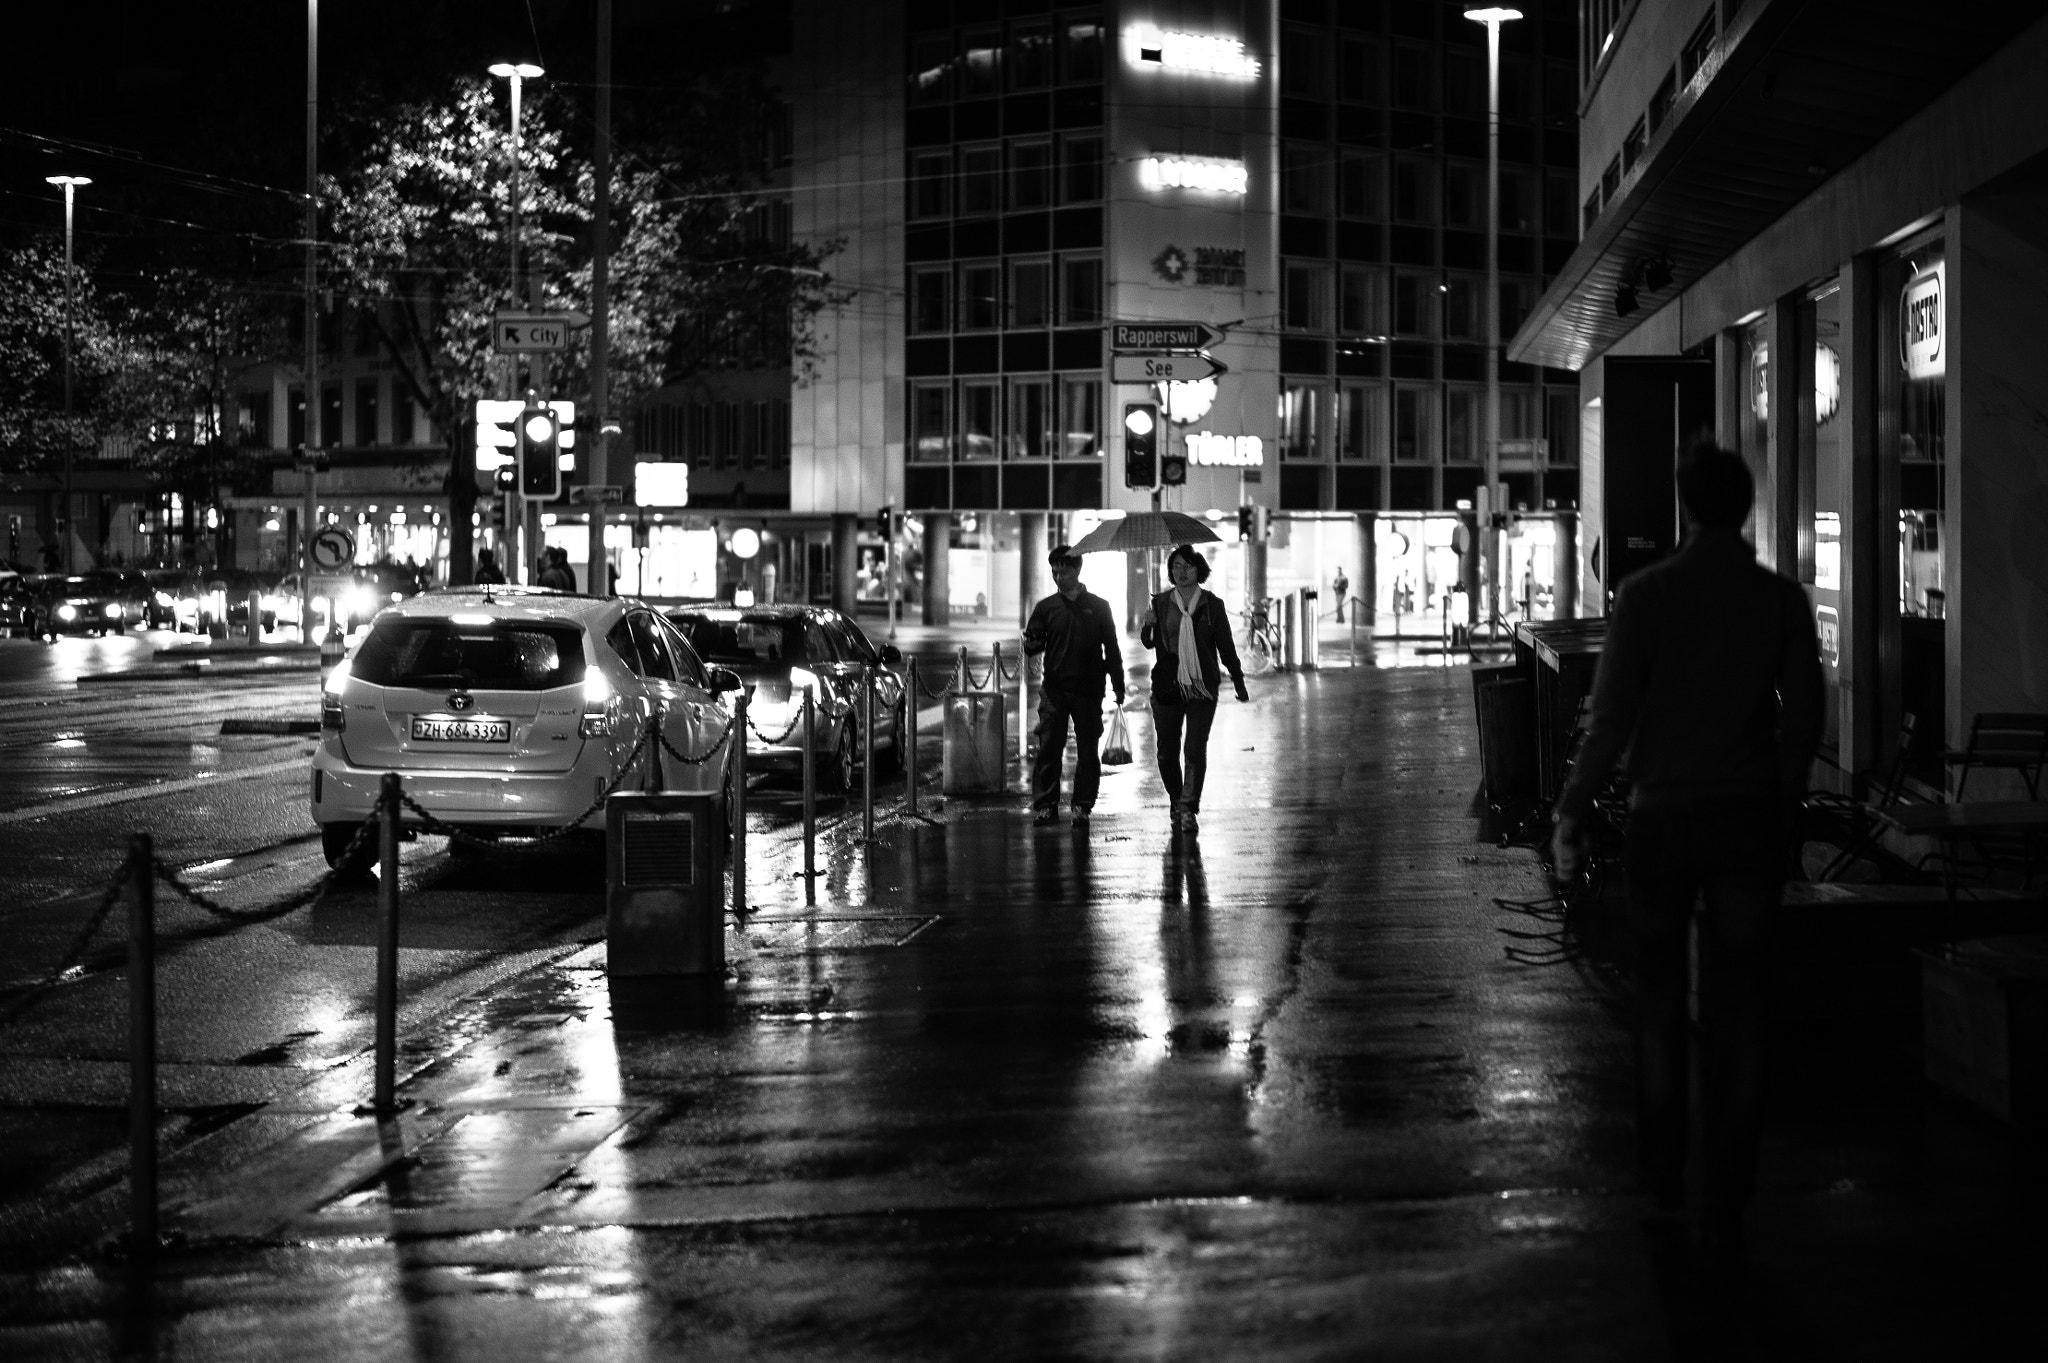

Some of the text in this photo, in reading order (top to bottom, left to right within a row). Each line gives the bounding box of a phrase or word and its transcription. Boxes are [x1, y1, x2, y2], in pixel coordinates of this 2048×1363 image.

[529, 326, 560, 345] City
[1117, 326, 1199, 347] Rapperswil
[1145, 359, 1174, 376] See
